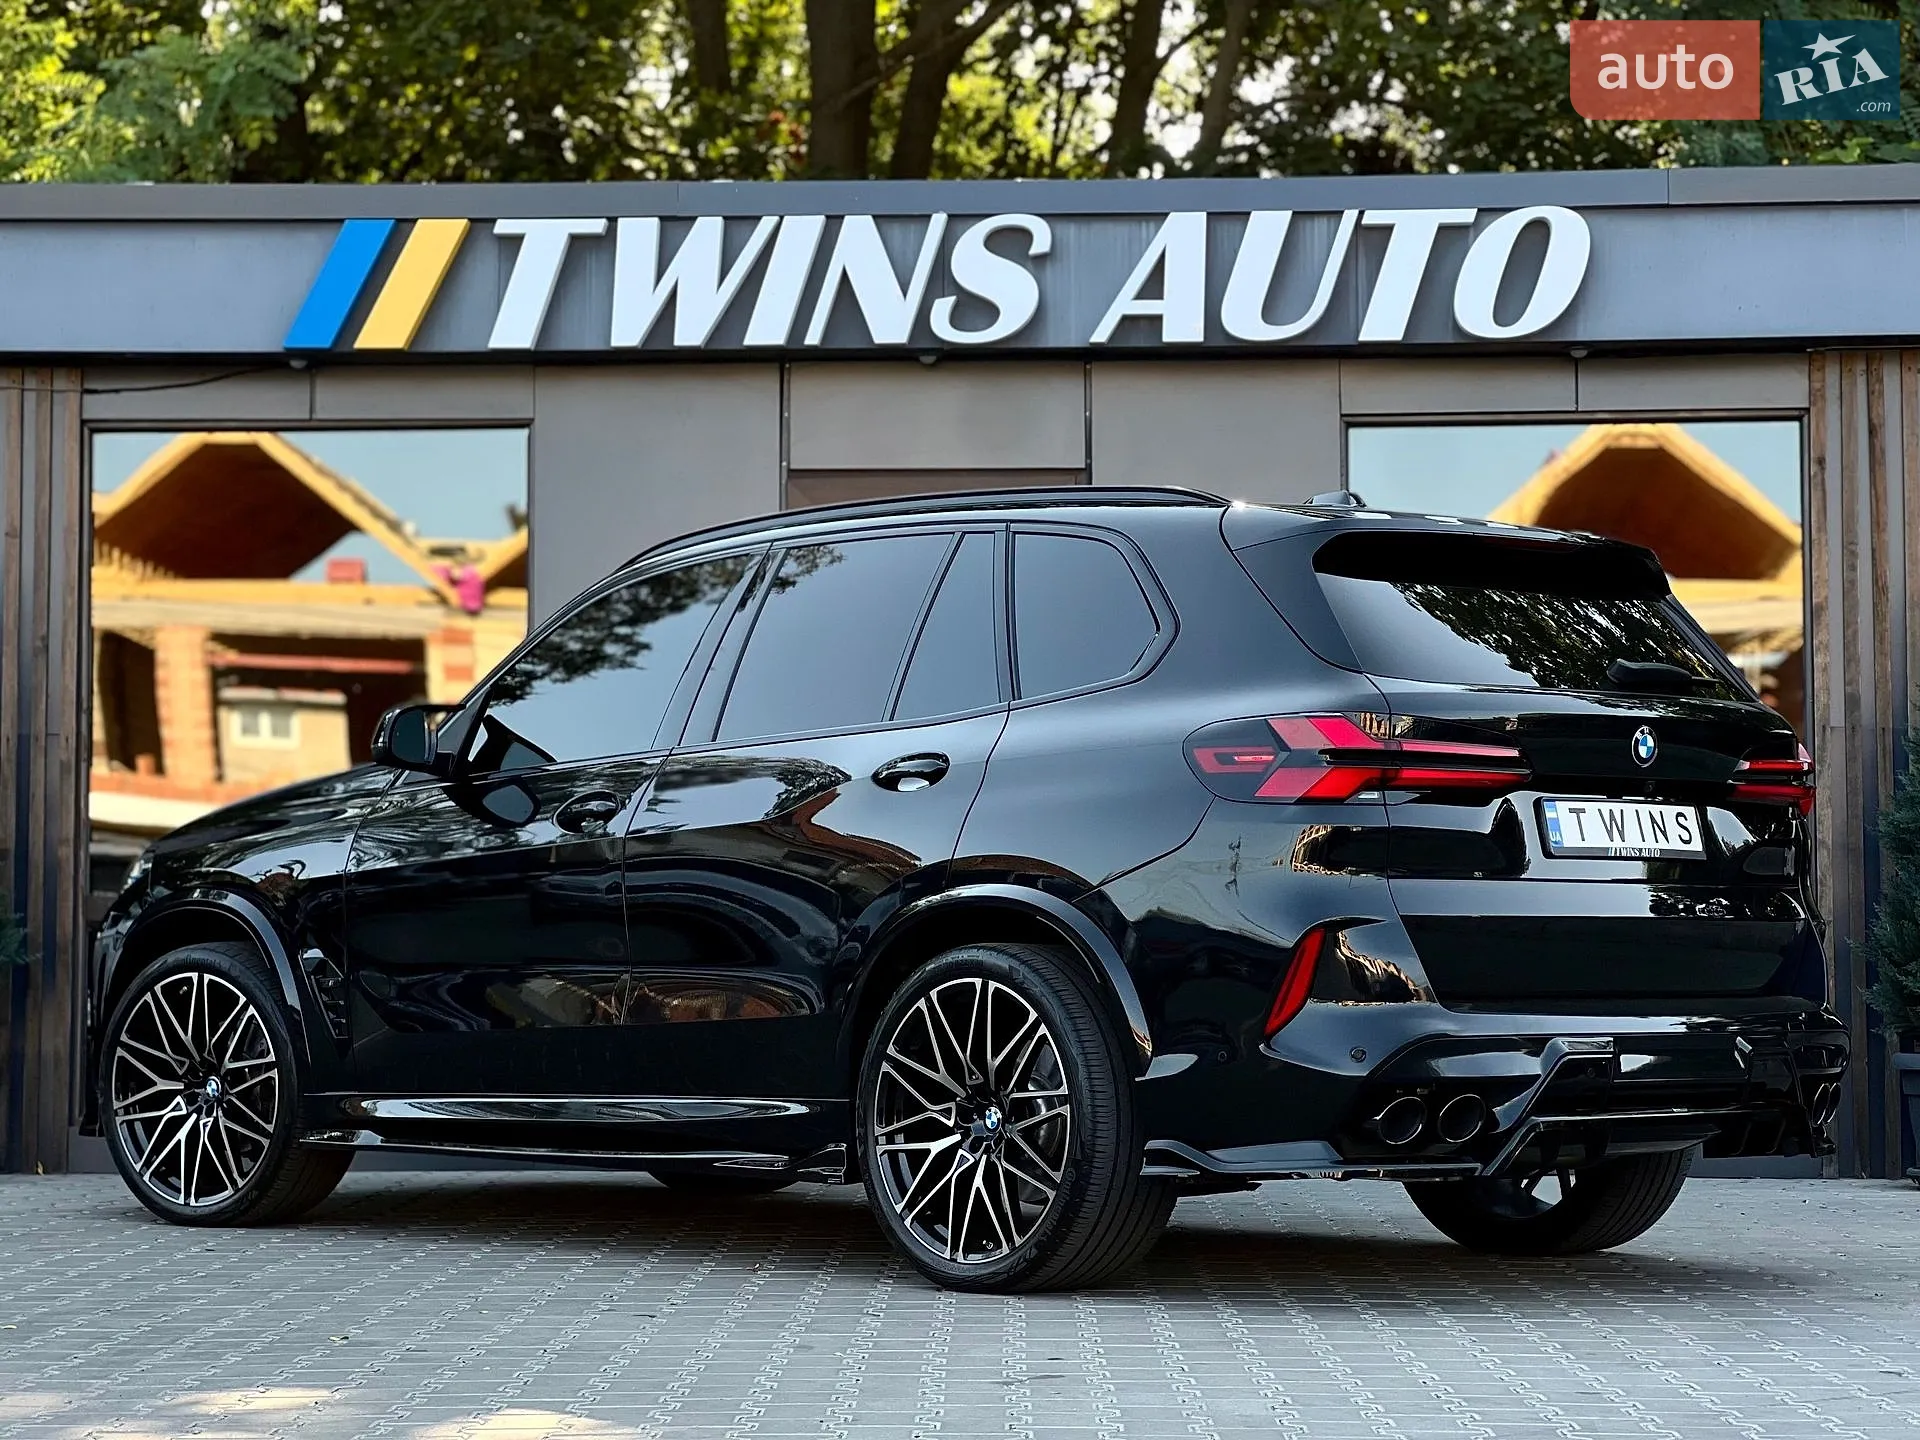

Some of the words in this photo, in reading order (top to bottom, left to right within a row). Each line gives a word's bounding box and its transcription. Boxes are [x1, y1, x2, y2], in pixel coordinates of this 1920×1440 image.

[488, 212, 1053, 350] TWINS
[1089, 205, 1592, 345] AUTO
[1550, 831, 1562, 843] UA
[1568, 807, 1693, 845] TWINS
[1616, 847, 1640, 857] TWINS
[1641, 848, 1661, 858] AUTO
